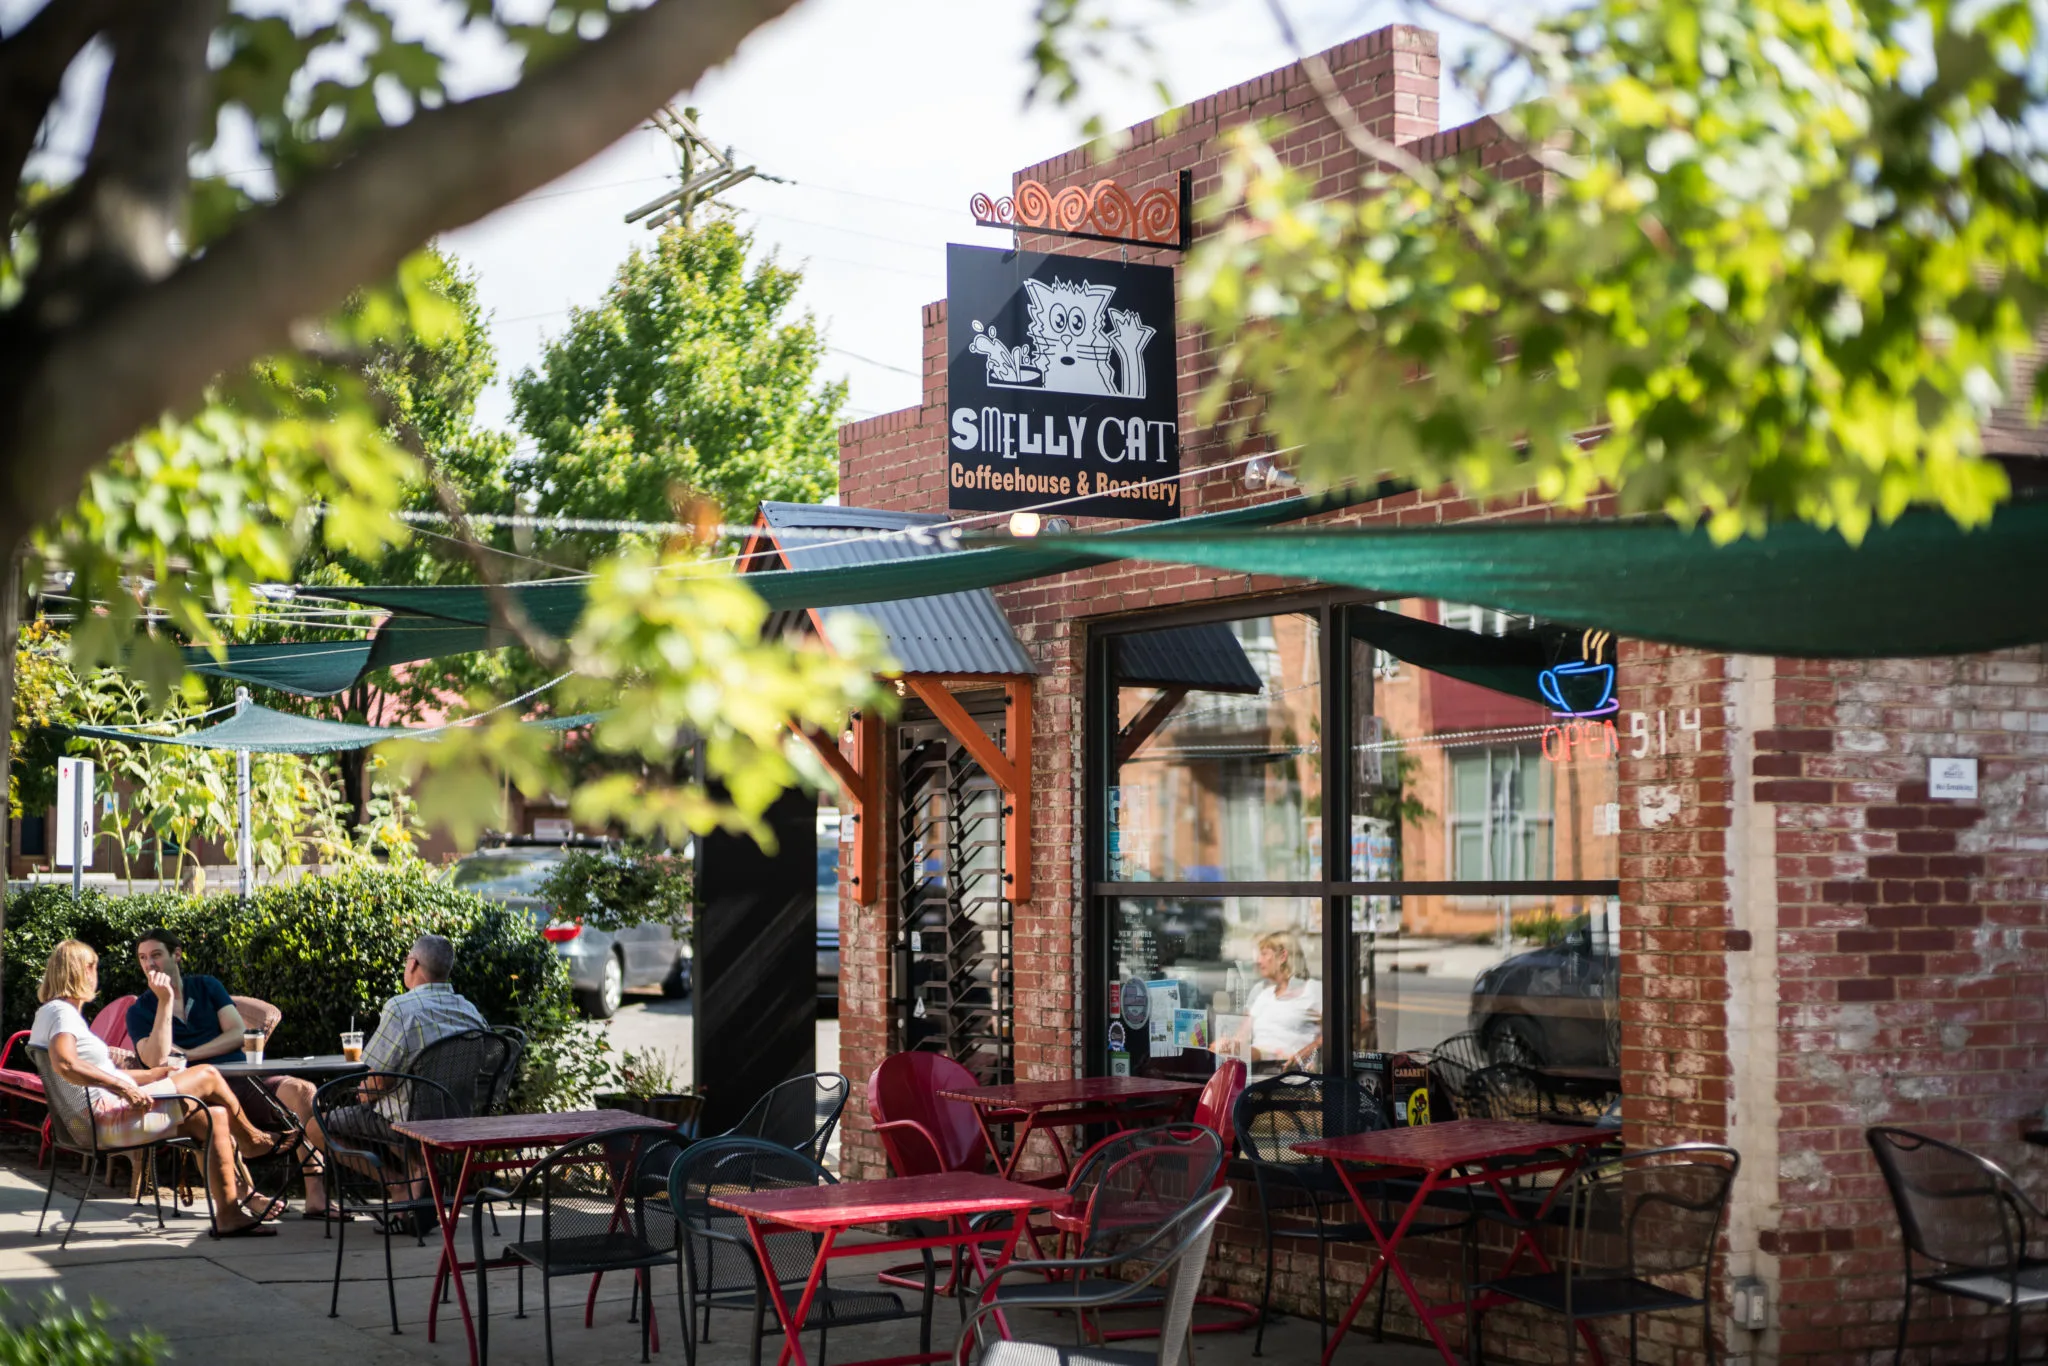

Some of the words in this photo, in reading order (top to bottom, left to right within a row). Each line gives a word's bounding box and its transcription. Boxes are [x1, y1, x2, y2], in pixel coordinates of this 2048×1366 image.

[951, 406, 1087, 459] SMELLY
[1097, 416, 1176, 463] CAT
[951, 462, 1071, 495] Coffeehouse
[1076, 470, 1090, 497] &
[1096, 472, 1178, 506] Roastery
[1541, 720, 1620, 762] OPEN
[1630, 708, 1701, 759] 514
[1394, 1069, 1425, 1077] CABARET
